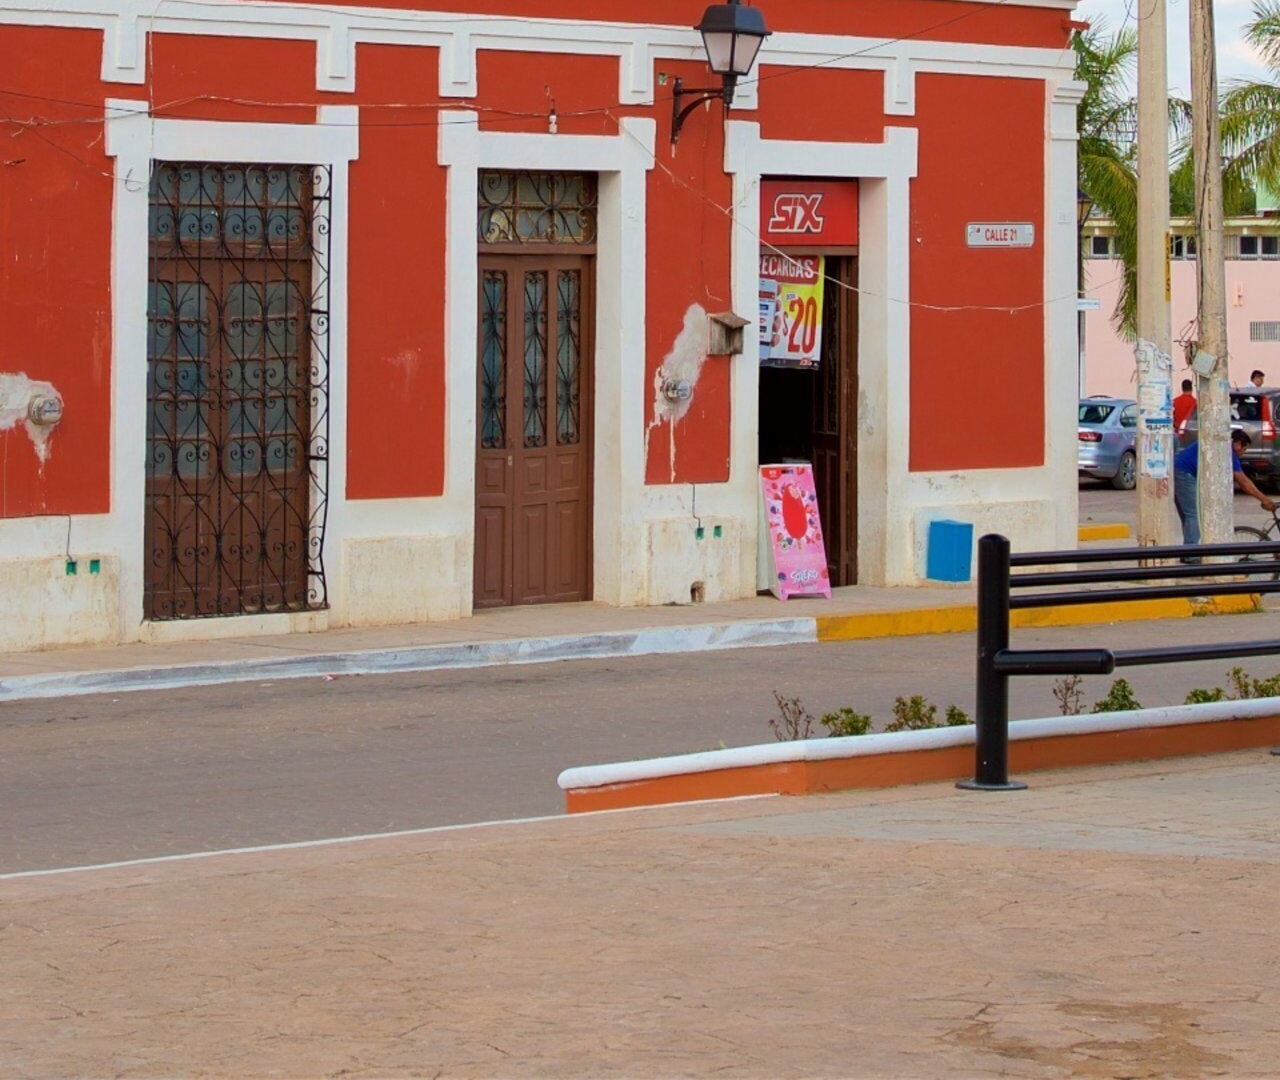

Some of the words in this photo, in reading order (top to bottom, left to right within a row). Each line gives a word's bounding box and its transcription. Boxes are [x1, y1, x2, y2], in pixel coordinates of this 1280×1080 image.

[985, 228, 1008, 241] CALLE
[1010, 228, 1018, 241] 21
[760, 255, 814, 279] ECARGAS
